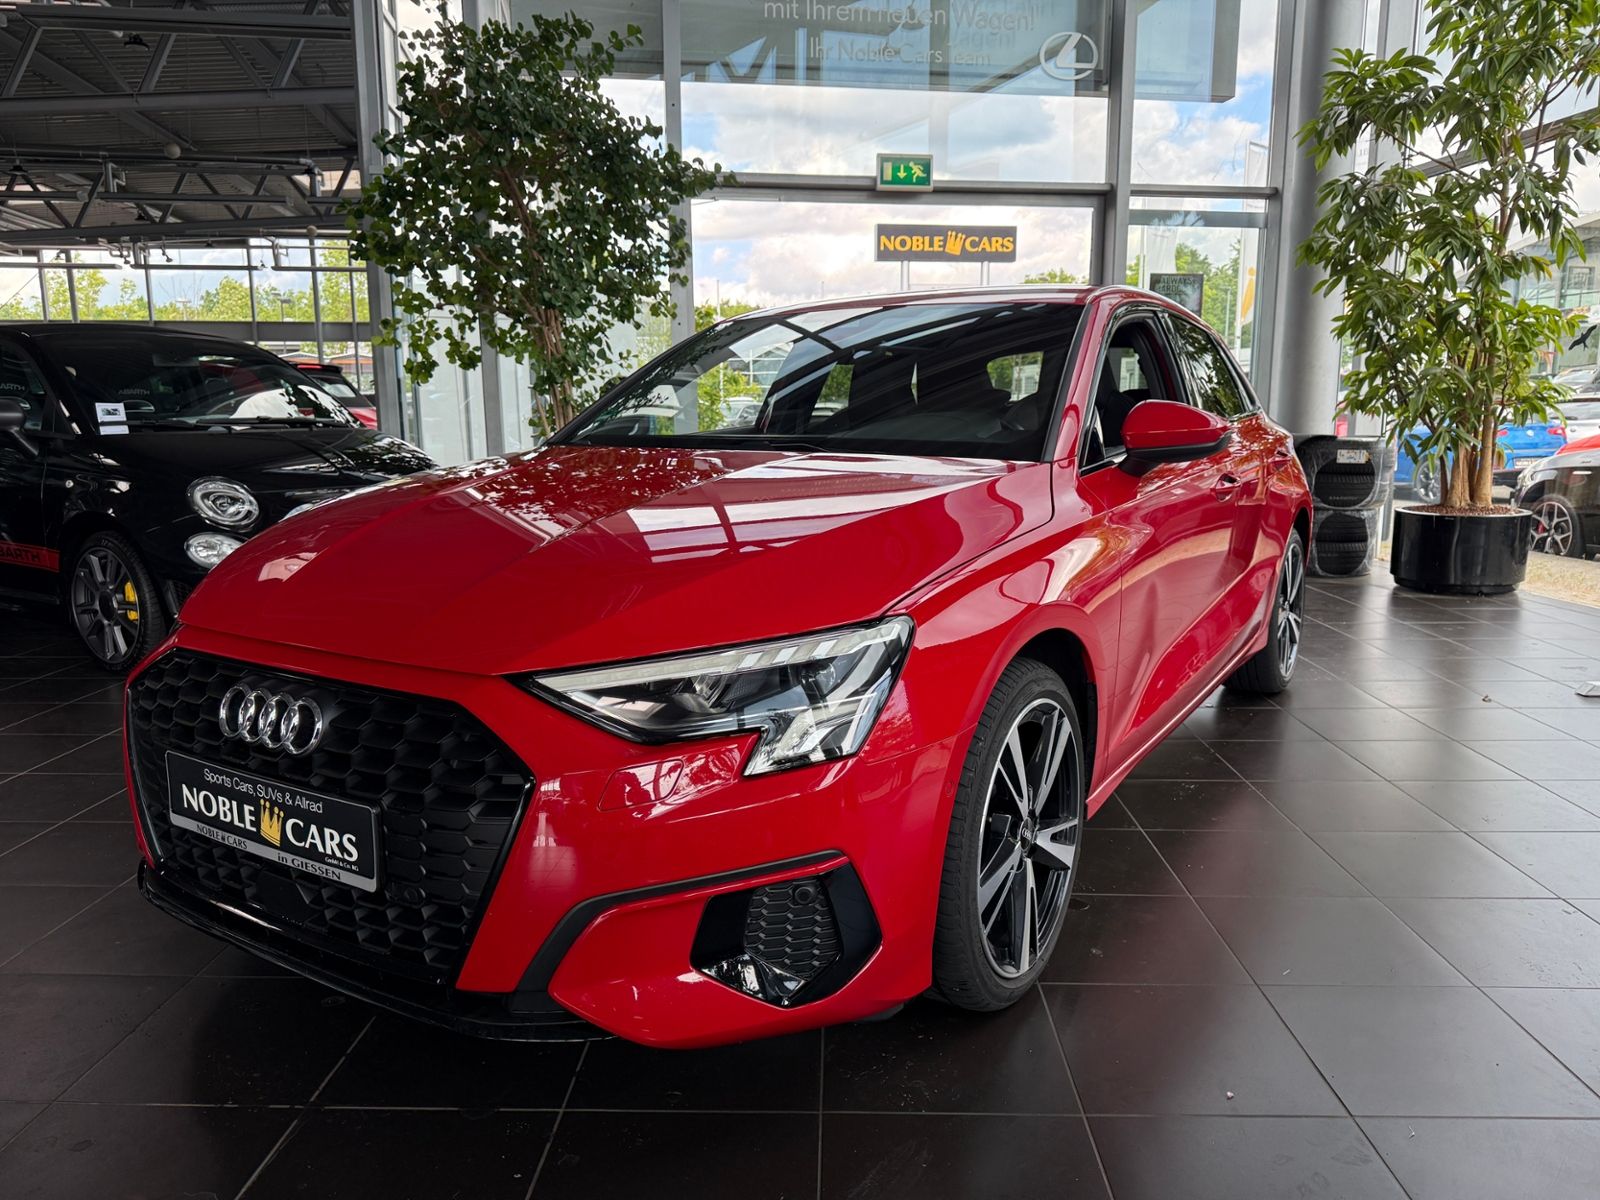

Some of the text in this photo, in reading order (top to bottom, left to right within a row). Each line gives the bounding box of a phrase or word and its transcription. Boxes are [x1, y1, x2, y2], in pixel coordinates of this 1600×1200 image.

[764, 0, 1034, 36] mit Ihrem neuen Wagen!
[810, 37, 829, 60] Ihr
[838, 38, 896, 62] Noble
[900, 43, 943, 64] Cars
[880, 235, 1014, 252] NOBLE CARS
[204, 768, 232, 787] Sports
[256, 784, 283, 803] SUVs
[284, 792, 293, 805] &
[294, 795, 323, 813] Allrad
[181, 784, 359, 862] NOBLE CARS
[196, 823, 248, 850] NOBLE CARS
[277, 852, 341, 880] in GIESSEN
